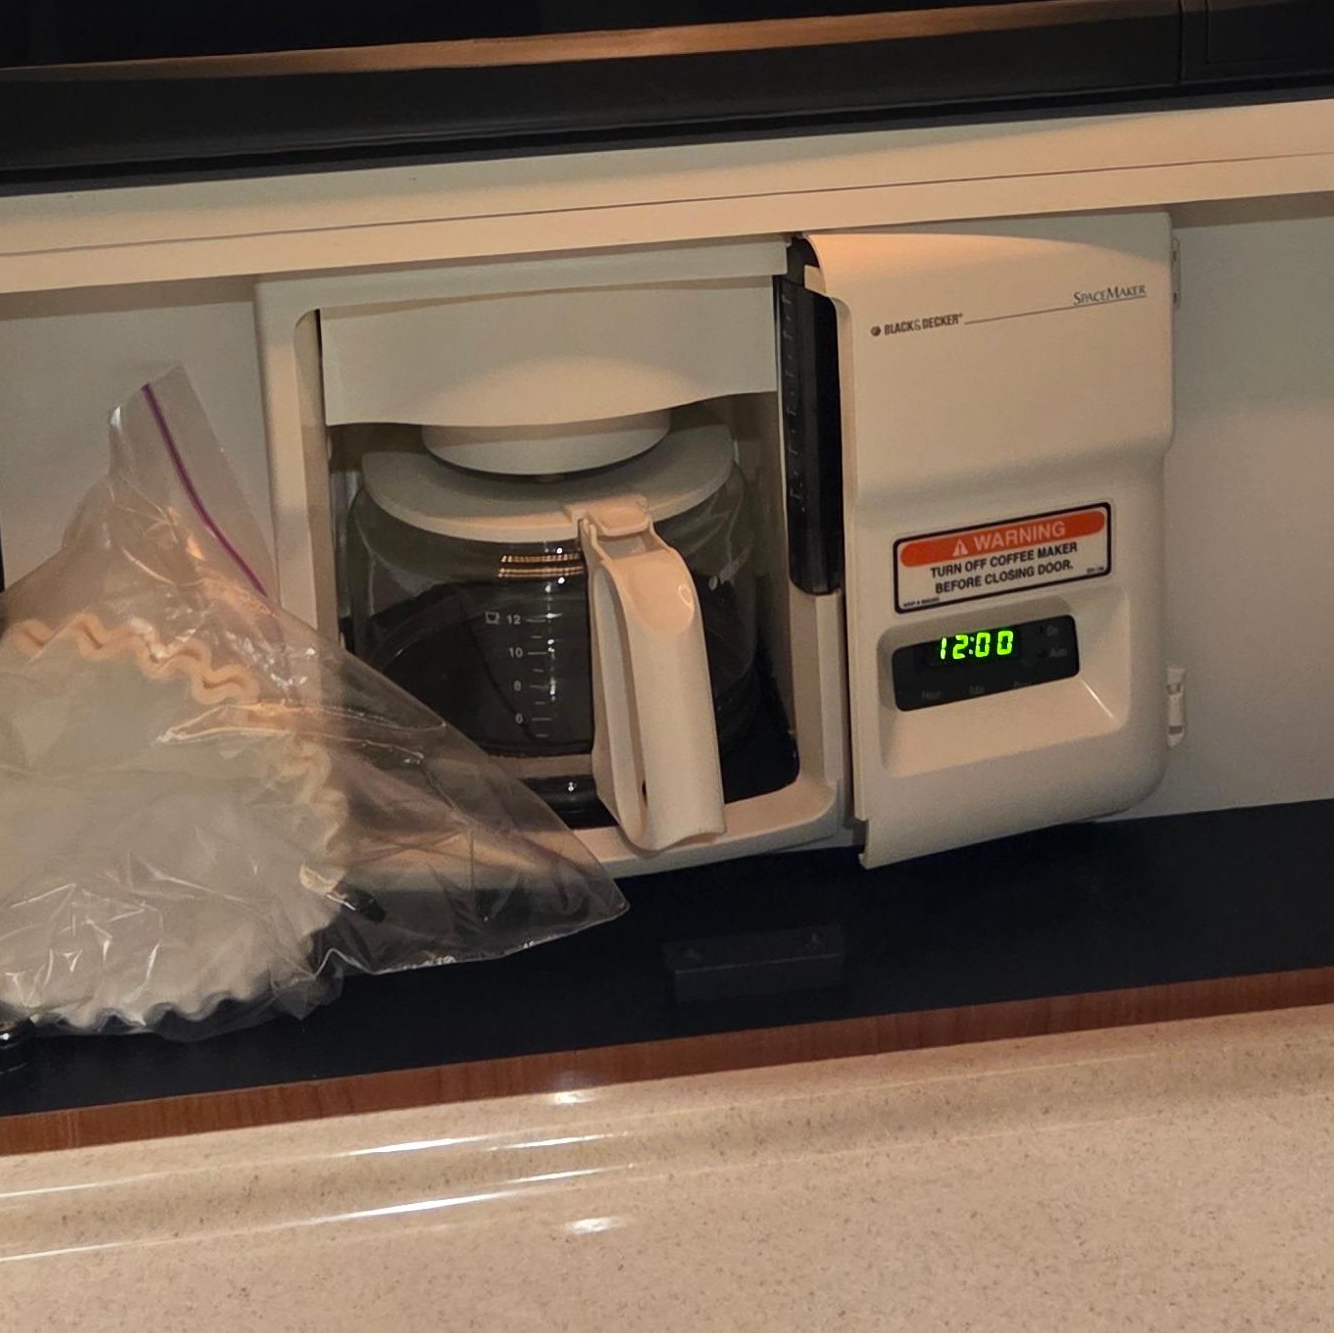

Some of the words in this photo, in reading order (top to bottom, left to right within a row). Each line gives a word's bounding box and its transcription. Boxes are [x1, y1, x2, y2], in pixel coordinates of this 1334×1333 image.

[973, 520, 1066, 552] WARNING
[930, 562, 963, 579] TURN
[964, 558, 987, 572] OFF
[989, 550, 1035, 568] COFFEE
[1037, 541, 1078, 559] MAKER
[935, 574, 982, 594] BEFORE
[984, 567, 1035, 585] CLOSING
[1037, 559, 1074, 576] DOOR.
[506, 613, 522, 625] 12
[508, 646, 524, 659] 10
[938, 629, 1015, 661] 12:00
